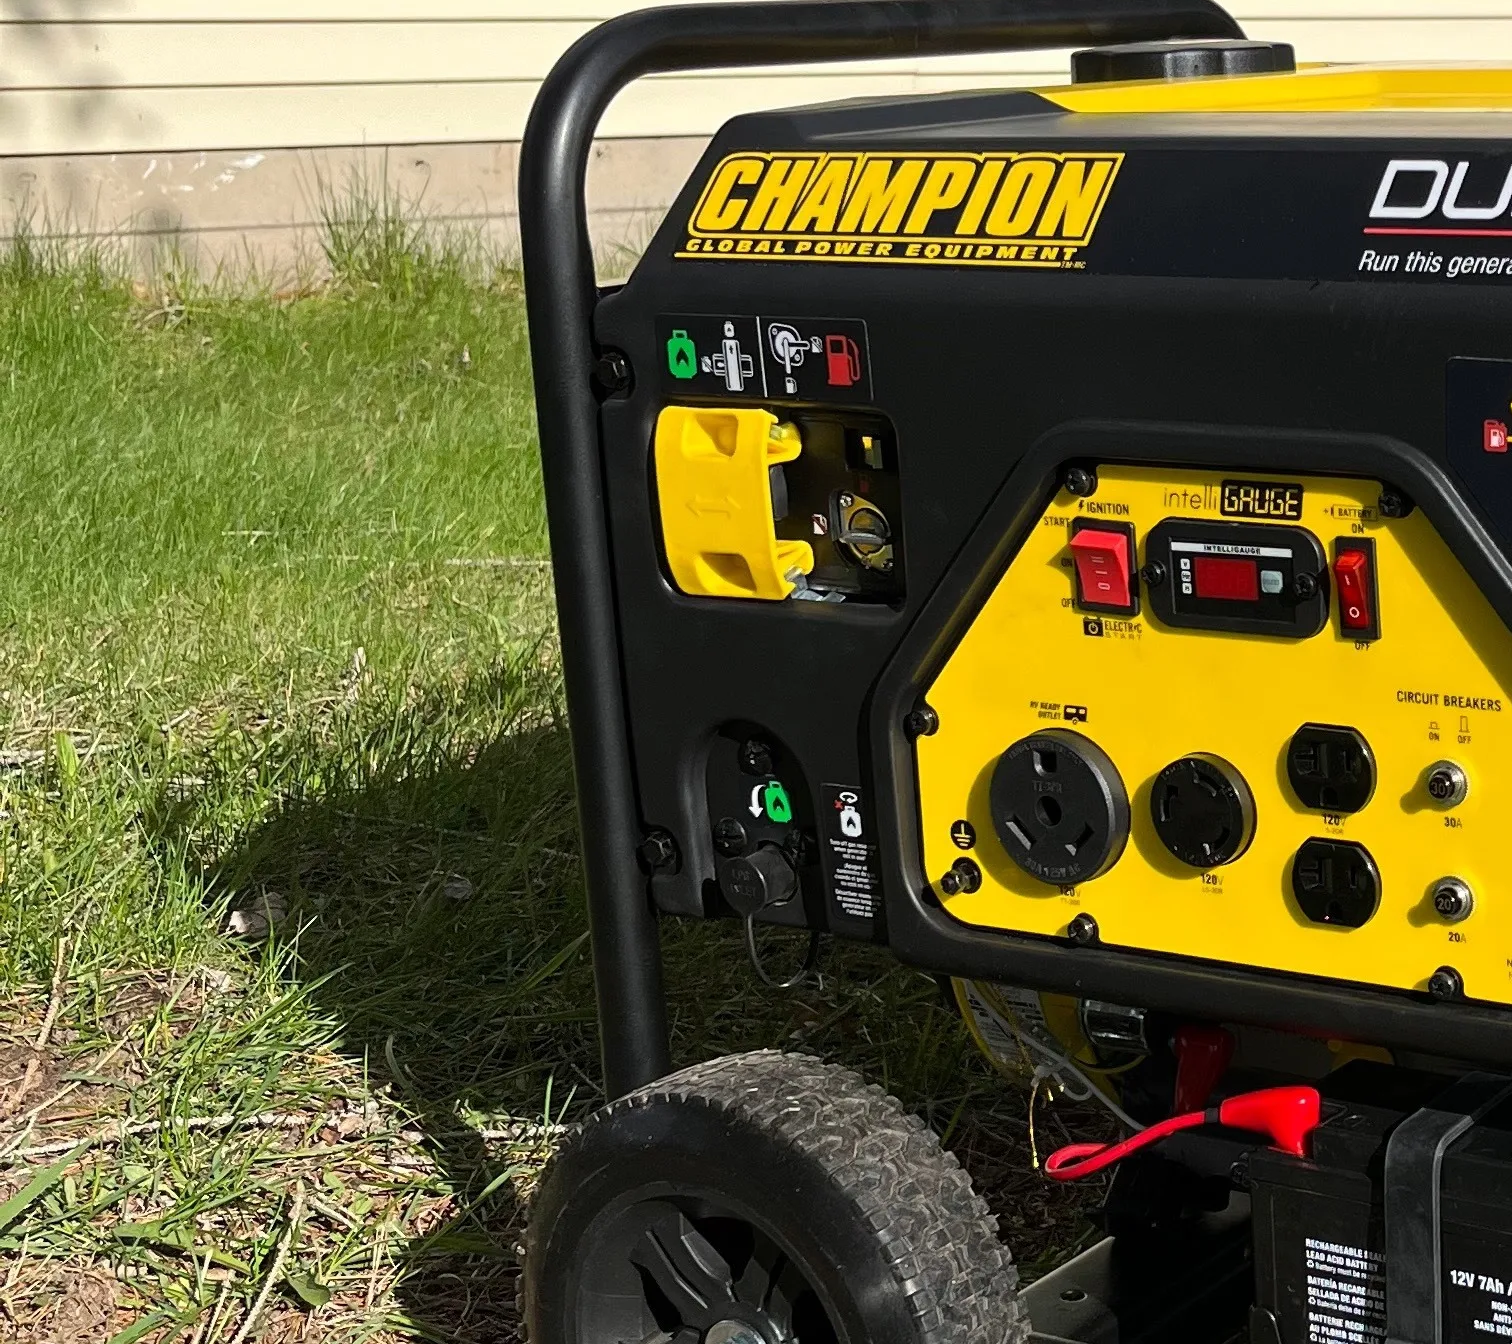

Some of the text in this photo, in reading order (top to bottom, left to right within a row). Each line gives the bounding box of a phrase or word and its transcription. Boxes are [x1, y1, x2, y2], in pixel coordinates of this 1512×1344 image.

[697, 154, 1117, 240] CHAMPION
[685, 238, 1079, 262] GLOBAL POWER EQUIPMENT
[1357, 249, 1399, 274] Run
[1406, 250, 1442, 275] this
[1086, 501, 1130, 515] IGNITION
[1338, 508, 1373, 518] BATTERY
[1043, 515, 1071, 528] START
[1351, 523, 1365, 534] ON
[1203, 545, 1261, 555] INTELLIGAUGE
[1061, 598, 1076, 608] OFF
[1104, 619, 1143, 634] ELECTRIC
[1105, 632, 1143, 641] START
[1396, 690, 1502, 712] CIRCUIT BREAKERS
[1428, 731, 1440, 742] ON
[1457, 735, 1472, 744] OFF
[1430, 782, 1446, 796] 30
[1444, 816, 1463, 829] 30A
[1200, 872, 1225, 886] 120V
[1436, 897, 1452, 911] 20
[1448, 931, 1467, 944] 20A
[1305, 1237, 1363, 1259] RECHARGEABLE
[1305, 1249, 1326, 1261] LEAD
[1326, 1254, 1345, 1266] ACID
[1449, 1268, 1476, 1287] 12V
[1477, 1274, 1505, 1294] 7Ah
[1307, 1286, 1340, 1301] SELLADA
[1308, 1311, 1344, 1327] BATTERIE
[1473, 1319, 1496, 1333] SANS
[1309, 1323, 1320, 1333] AU
[1320, 1326, 1347, 1339] PLOMB
